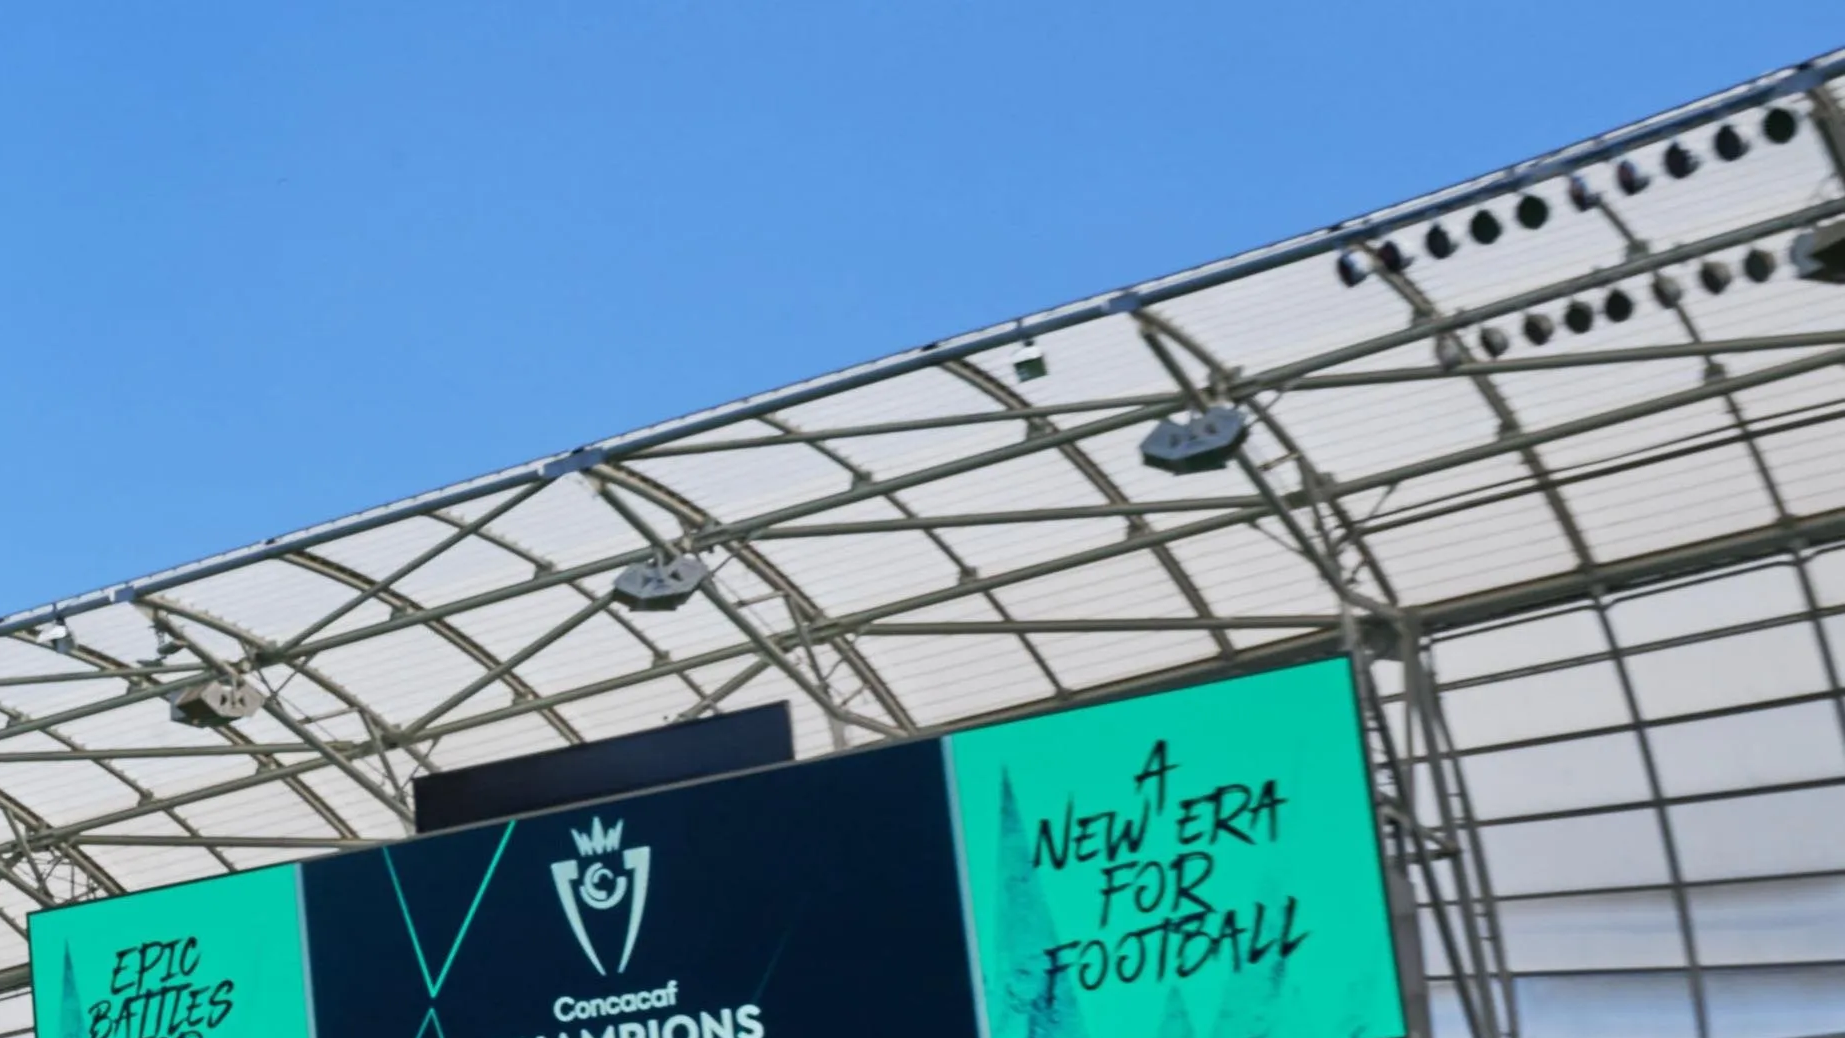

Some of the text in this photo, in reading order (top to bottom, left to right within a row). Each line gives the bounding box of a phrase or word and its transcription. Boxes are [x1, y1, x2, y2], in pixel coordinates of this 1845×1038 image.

[1134, 741, 1179, 814] A
[1031, 780, 1287, 869] NEW ERA
[1099, 851, 1216, 929] FOR
[110, 936, 200, 997] EPIC
[1042, 896, 1312, 1006] FOOTBALL
[553, 982, 679, 1023] Concacaf
